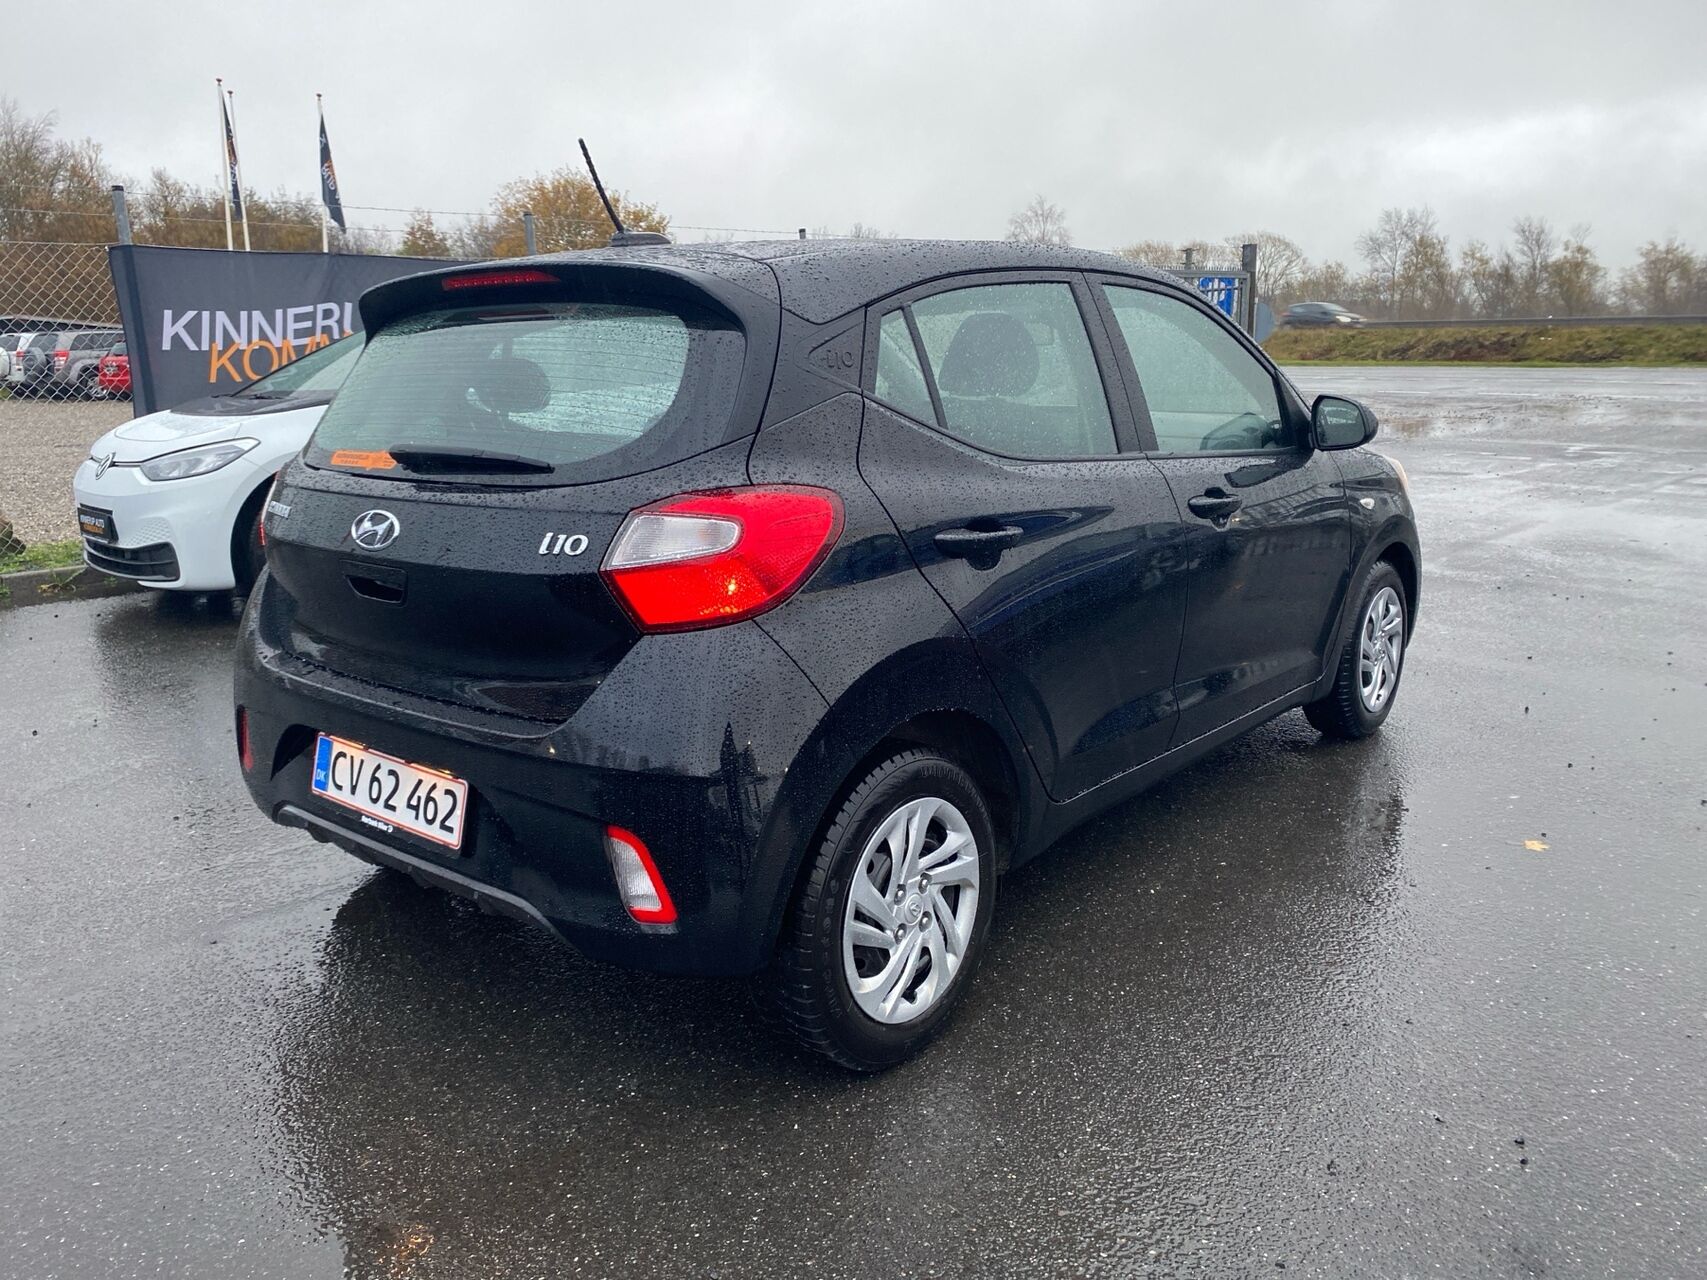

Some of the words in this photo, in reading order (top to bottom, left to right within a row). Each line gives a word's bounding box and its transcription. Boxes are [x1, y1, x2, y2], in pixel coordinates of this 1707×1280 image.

[316, 768, 326, 782] DK
[331, 751, 364, 796] CV
[368, 763, 400, 813] 62
[406, 778, 457, 834] 462
